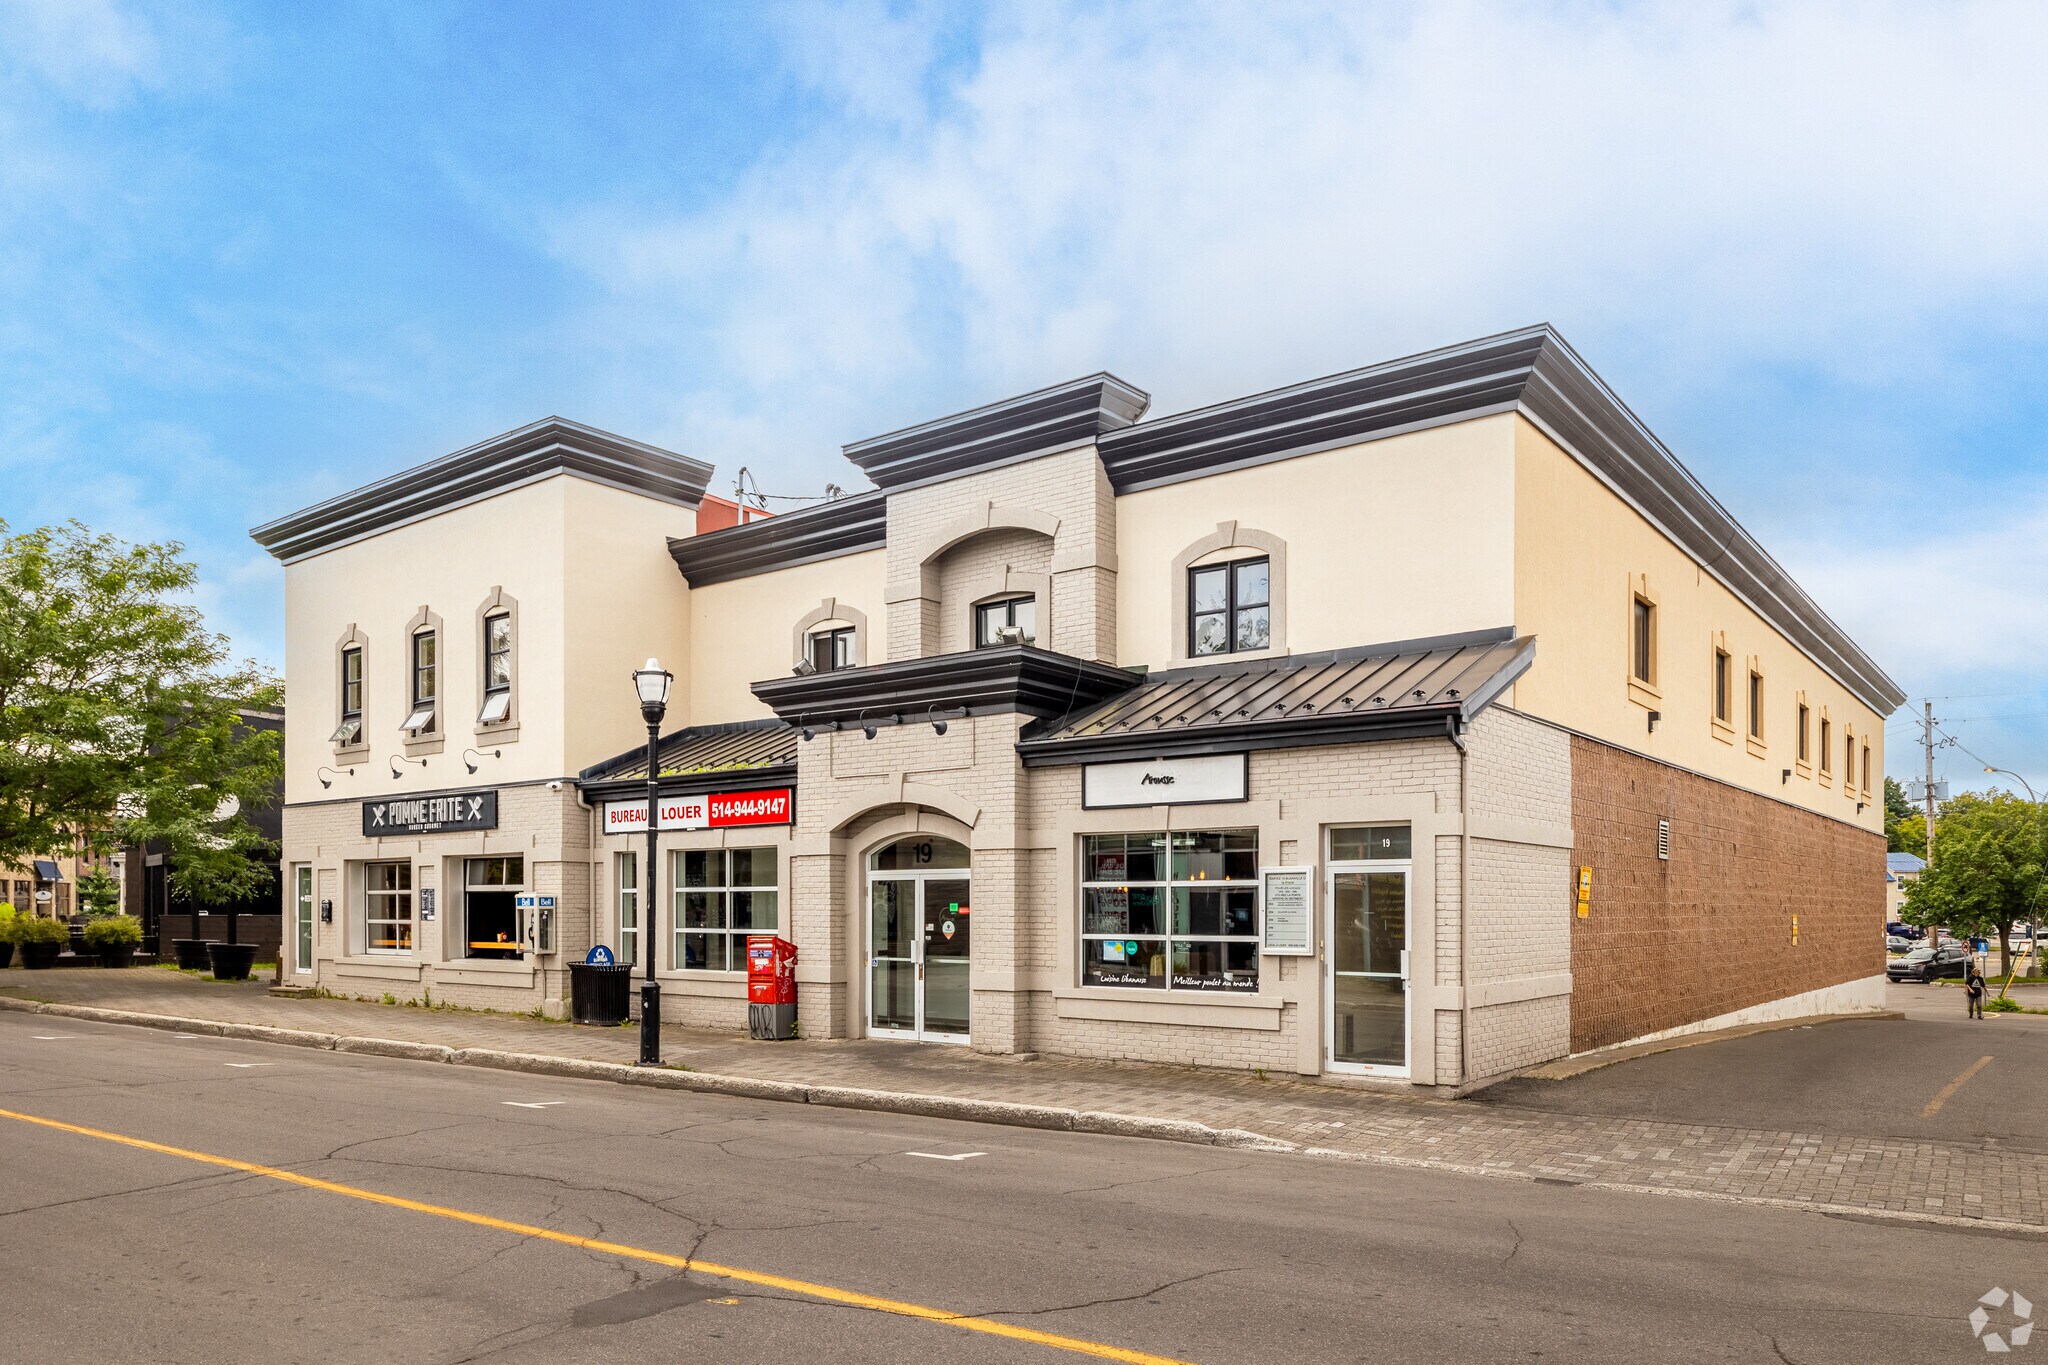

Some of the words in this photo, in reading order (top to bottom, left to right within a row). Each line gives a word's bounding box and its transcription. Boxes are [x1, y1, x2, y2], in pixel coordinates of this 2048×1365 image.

[1141, 773, 1175, 785] Arousse
[389, 800, 427, 826] POMME
[428, 796, 464, 823] FRITE
[610, 808, 648, 823] BUREAU
[661, 805, 702, 820] LOUER
[711, 797, 786, 819] 514-944-9147
[1382, 838, 1391, 848] 19
[913, 843, 932, 863] 19
[522, 898, 530, 906] Bell
[541, 898, 551, 906] Bell
[1173, 976, 1202, 986] Meilleur
[1202, 978, 1221, 989] poulet
[1233, 977, 1254, 987] monde
